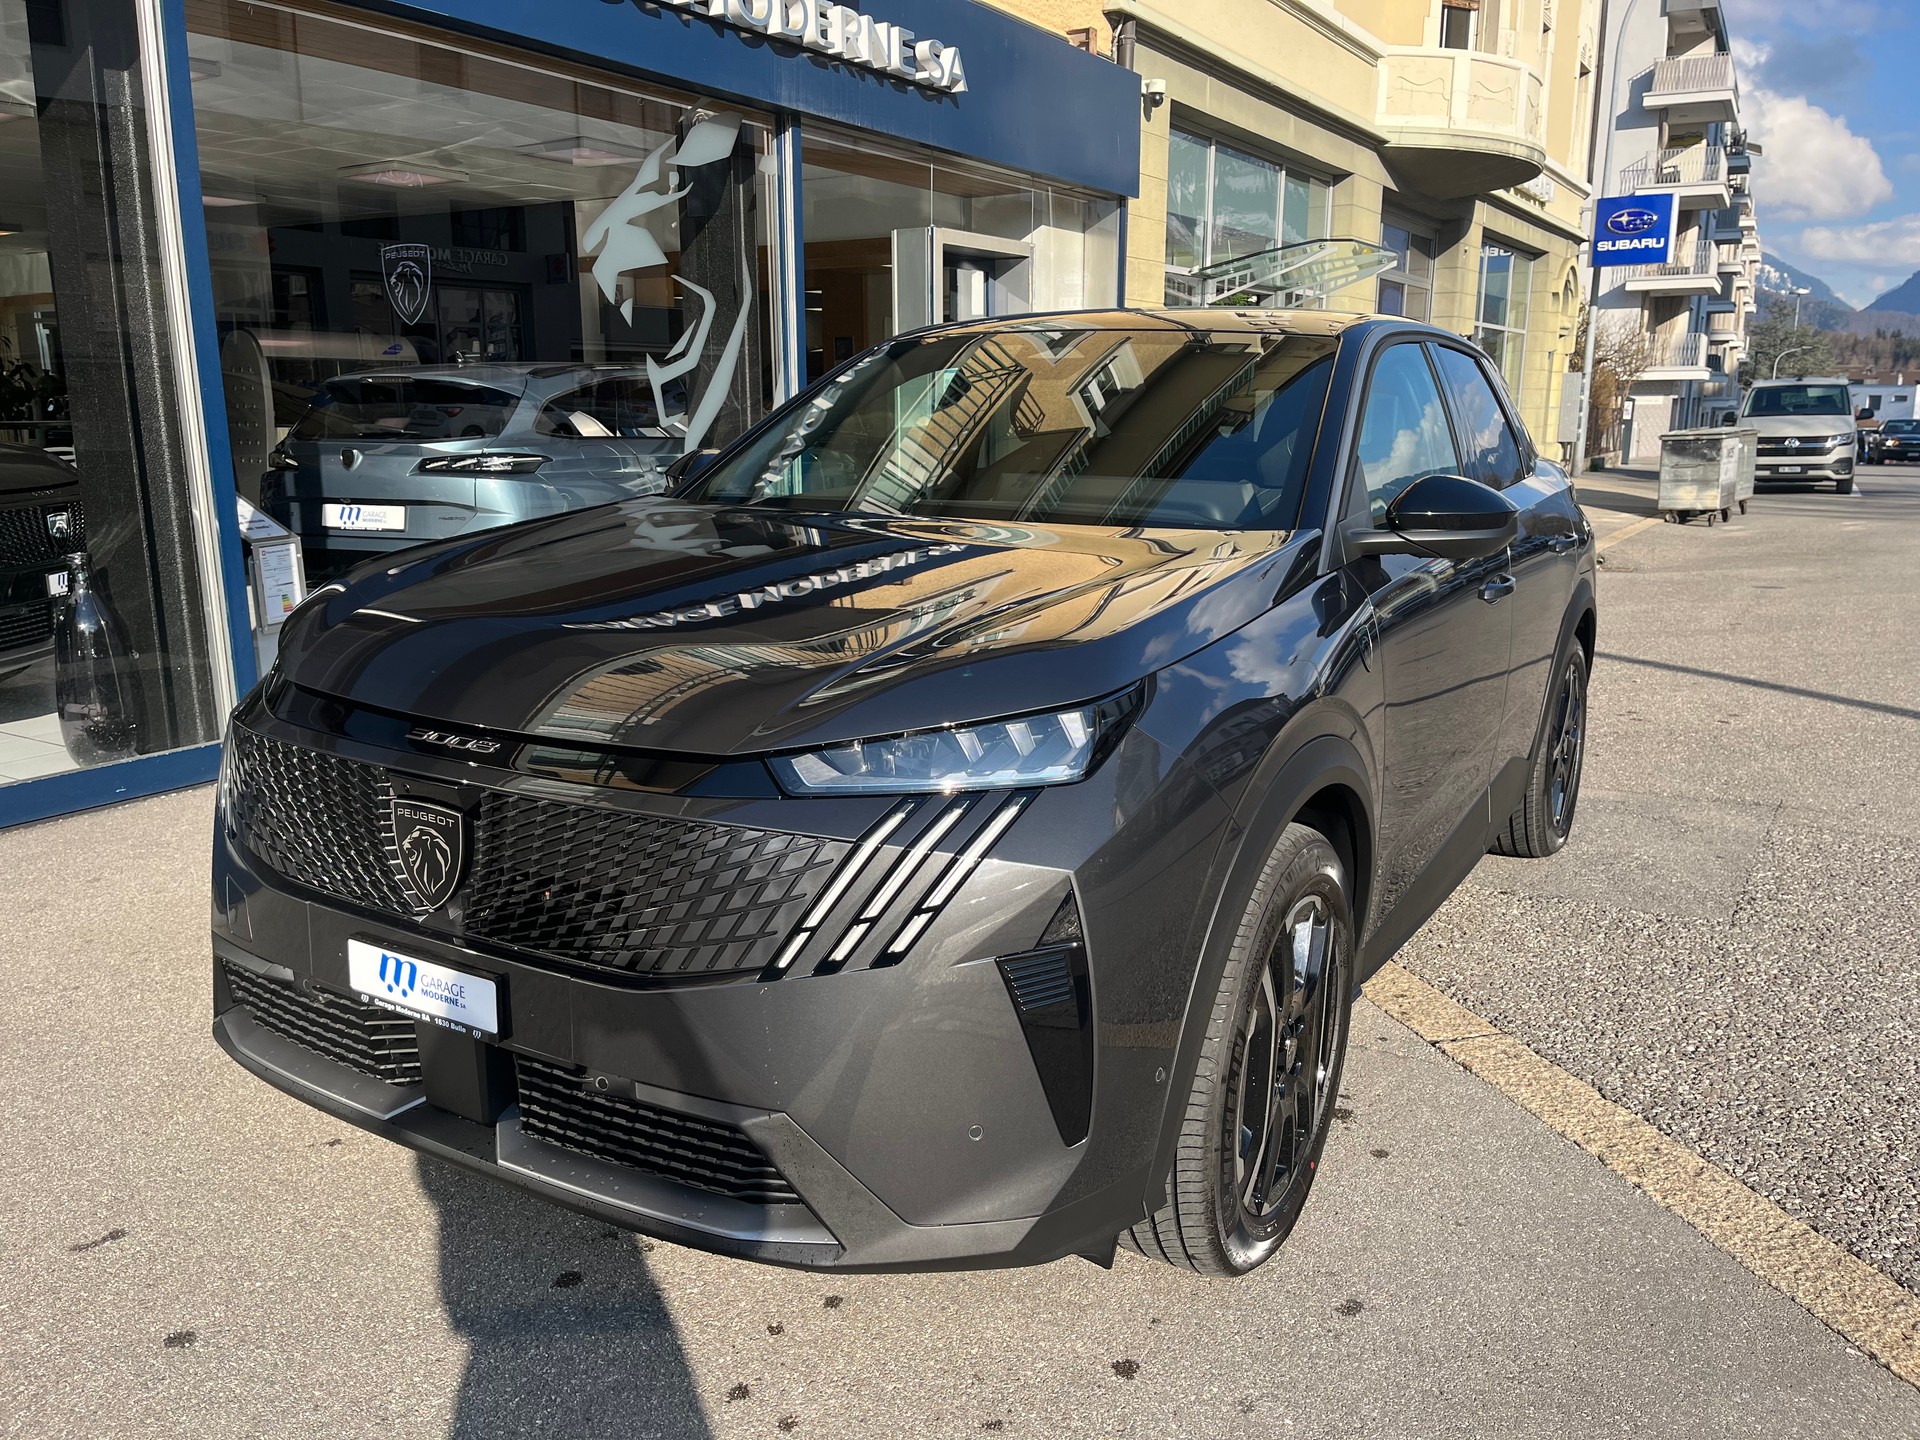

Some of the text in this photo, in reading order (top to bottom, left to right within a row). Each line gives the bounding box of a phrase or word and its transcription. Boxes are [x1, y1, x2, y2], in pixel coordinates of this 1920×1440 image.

[914, 38, 968, 93] SA
[385, 249, 427, 260] PEUGEOT
[1597, 238, 1665, 252] SUBARU
[405, 728, 500, 754] 3008
[397, 808, 455, 828] PEUGEOT
[420, 974, 466, 999] GARAGE
[421, 988, 460, 1008] MODERNE
[374, 998, 395, 1012] Garage
[395, 1004, 421, 1019] Moderne
[421, 1013, 431, 1023] SA
[434, 1017, 450, 1028] 1630
[1223, 1028, 1246, 1184] MICHELIN
